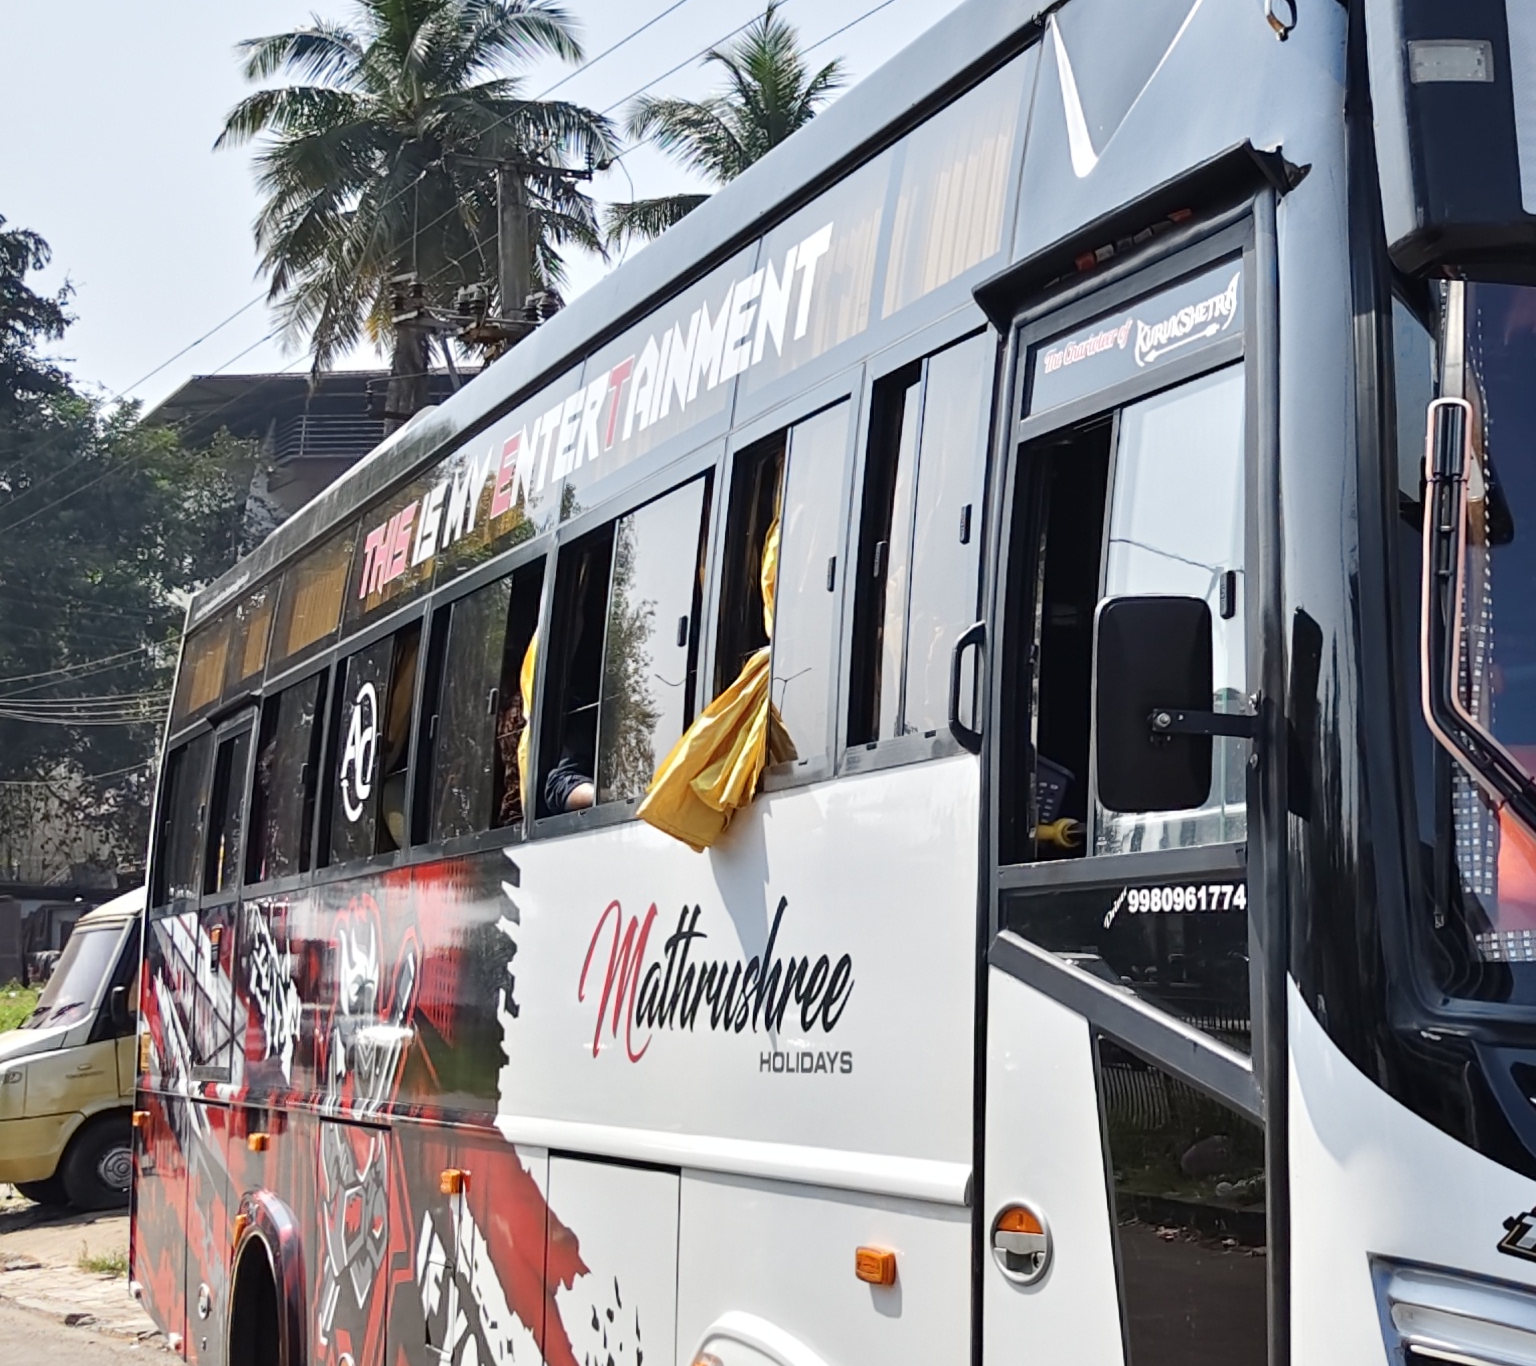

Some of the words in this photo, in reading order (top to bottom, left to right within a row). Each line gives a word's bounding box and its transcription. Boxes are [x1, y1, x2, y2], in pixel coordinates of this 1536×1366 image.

[359, 500, 418, 600] THIS
[411, 481, 449, 567] IS
[441, 444, 494, 549] MY
[490, 221, 834, 519] ENTERTAINMENT
[1127, 884, 1246, 914] 9980961774
[578, 895, 855, 1063] Mathrushree
[759, 1051, 853, 1074] HOLIDAYS
